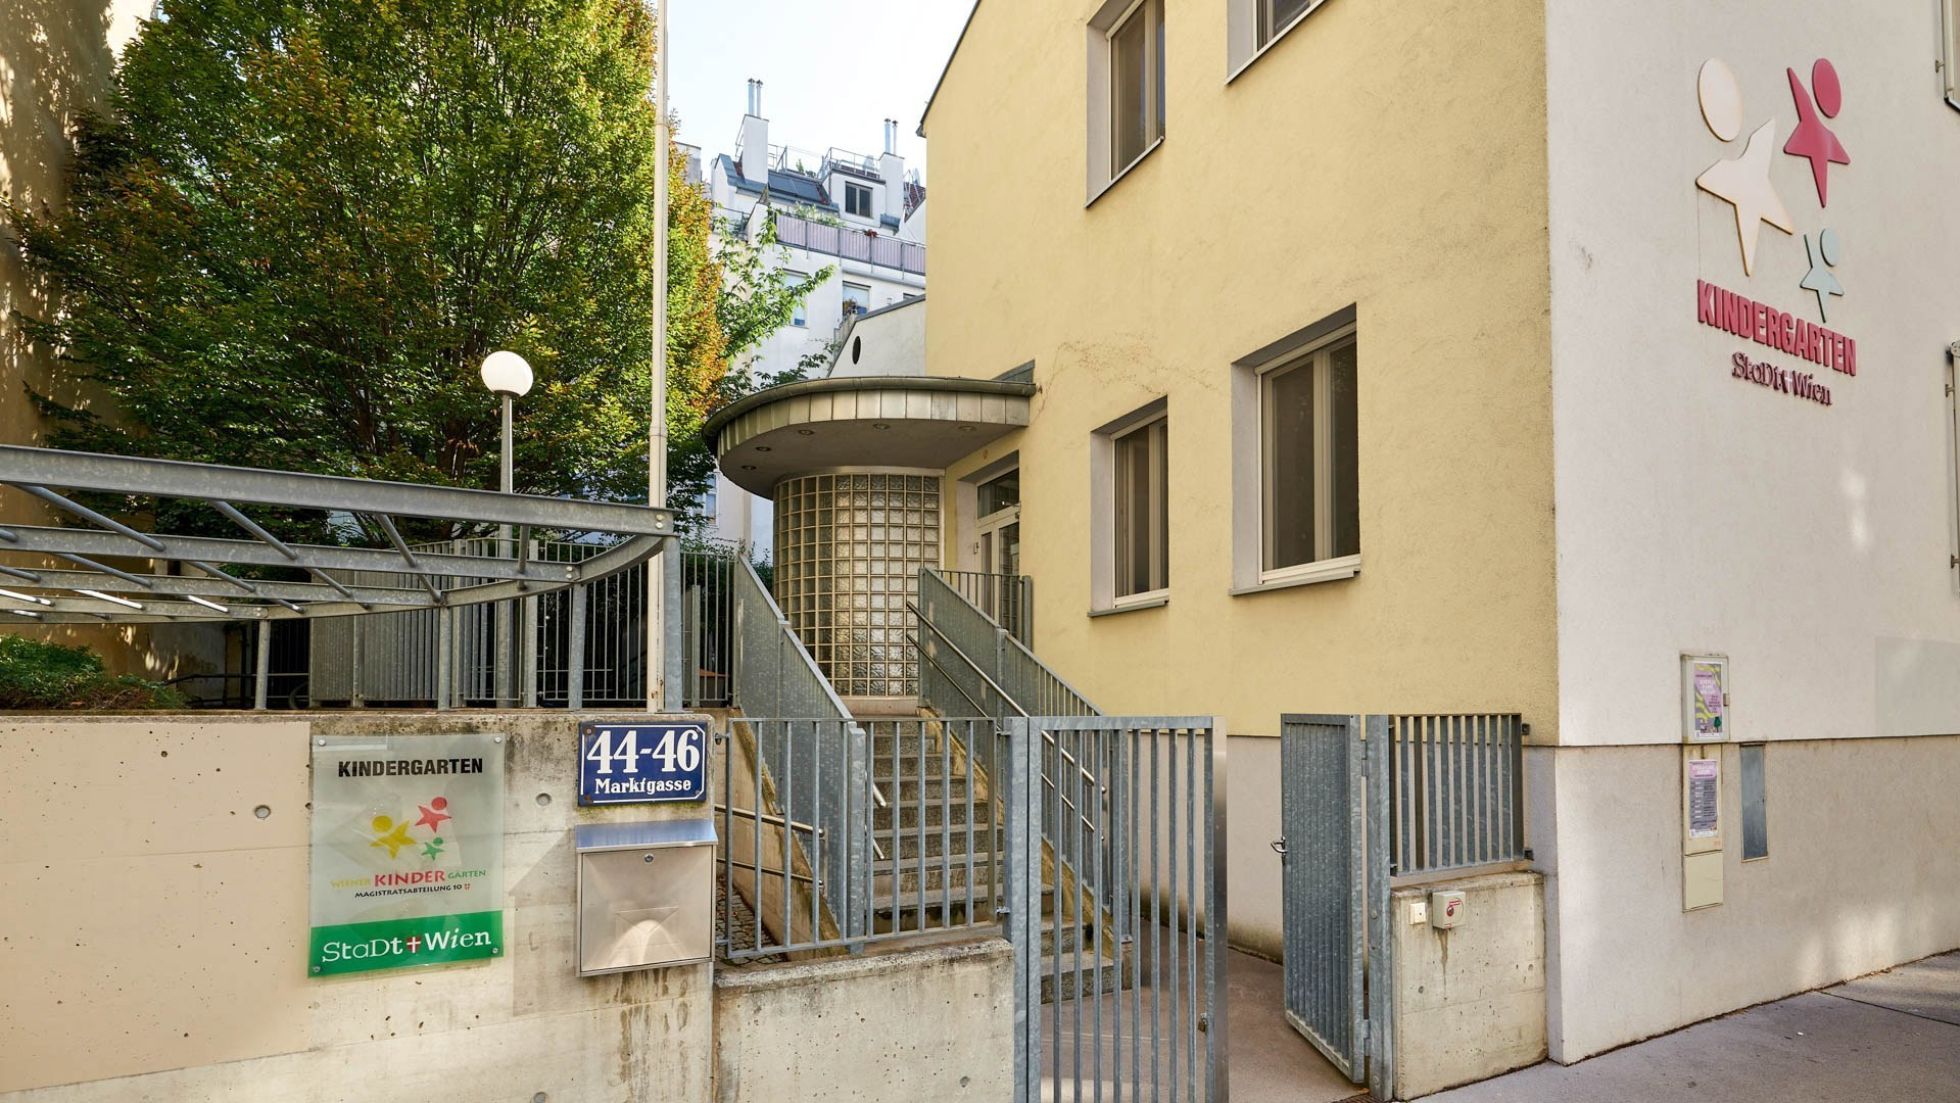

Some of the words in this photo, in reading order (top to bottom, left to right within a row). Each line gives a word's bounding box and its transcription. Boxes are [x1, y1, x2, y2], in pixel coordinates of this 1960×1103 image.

[1697, 279, 1856, 376] KINDERGARTEN
[1792, 370, 1832, 406] Wien
[586, 729, 700, 774] 44-46
[338, 758, 483, 777] KINDERGARTEN
[595, 777, 692, 795] Marktgasse
[354, 885, 451, 898] MAGISTRATSABTEILUNG
[374, 870, 446, 887] KINDER
[447, 870, 487, 879] GARTEN
[322, 937, 404, 962] StaDt
[424, 928, 492, 951] Wien
